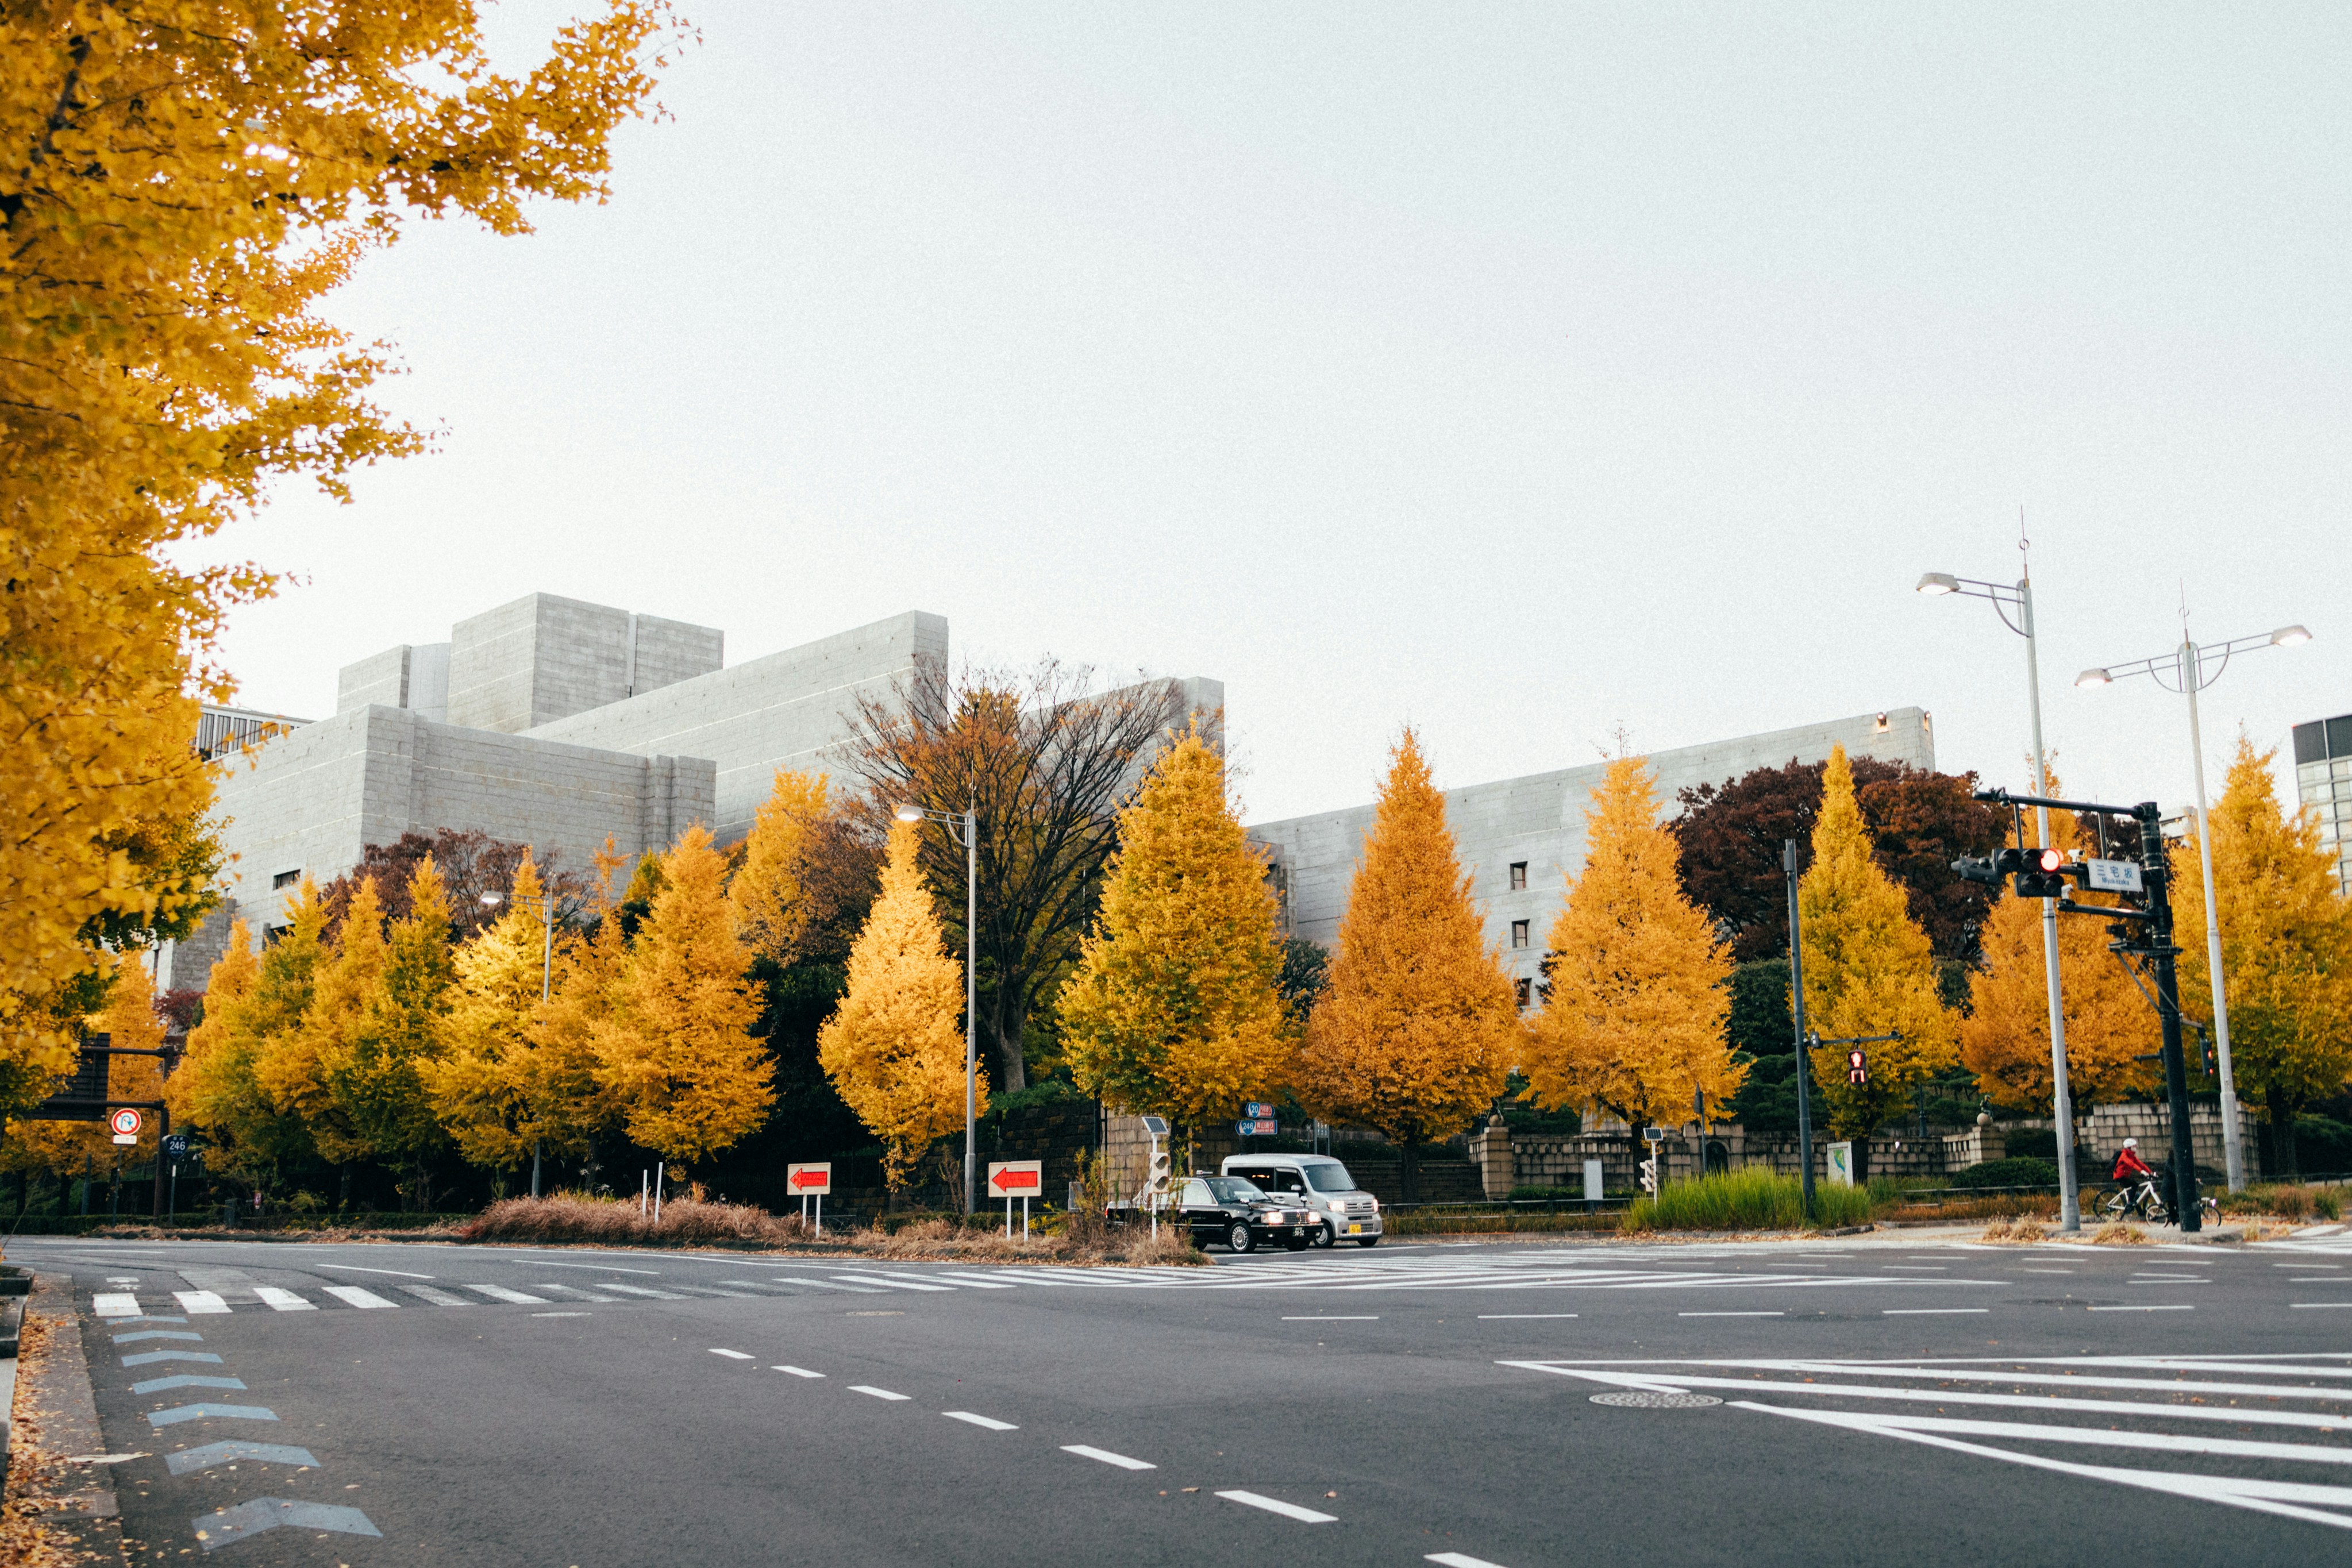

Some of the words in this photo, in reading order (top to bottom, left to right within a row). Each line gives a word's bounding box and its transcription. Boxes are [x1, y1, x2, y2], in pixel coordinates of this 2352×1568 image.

[2096, 865, 2133, 879] 三宅坂
[2101, 877, 2130, 885] Miyakezaka
[1251, 1105, 1258, 1114] 20
[170, 1141, 186, 1150] 246
